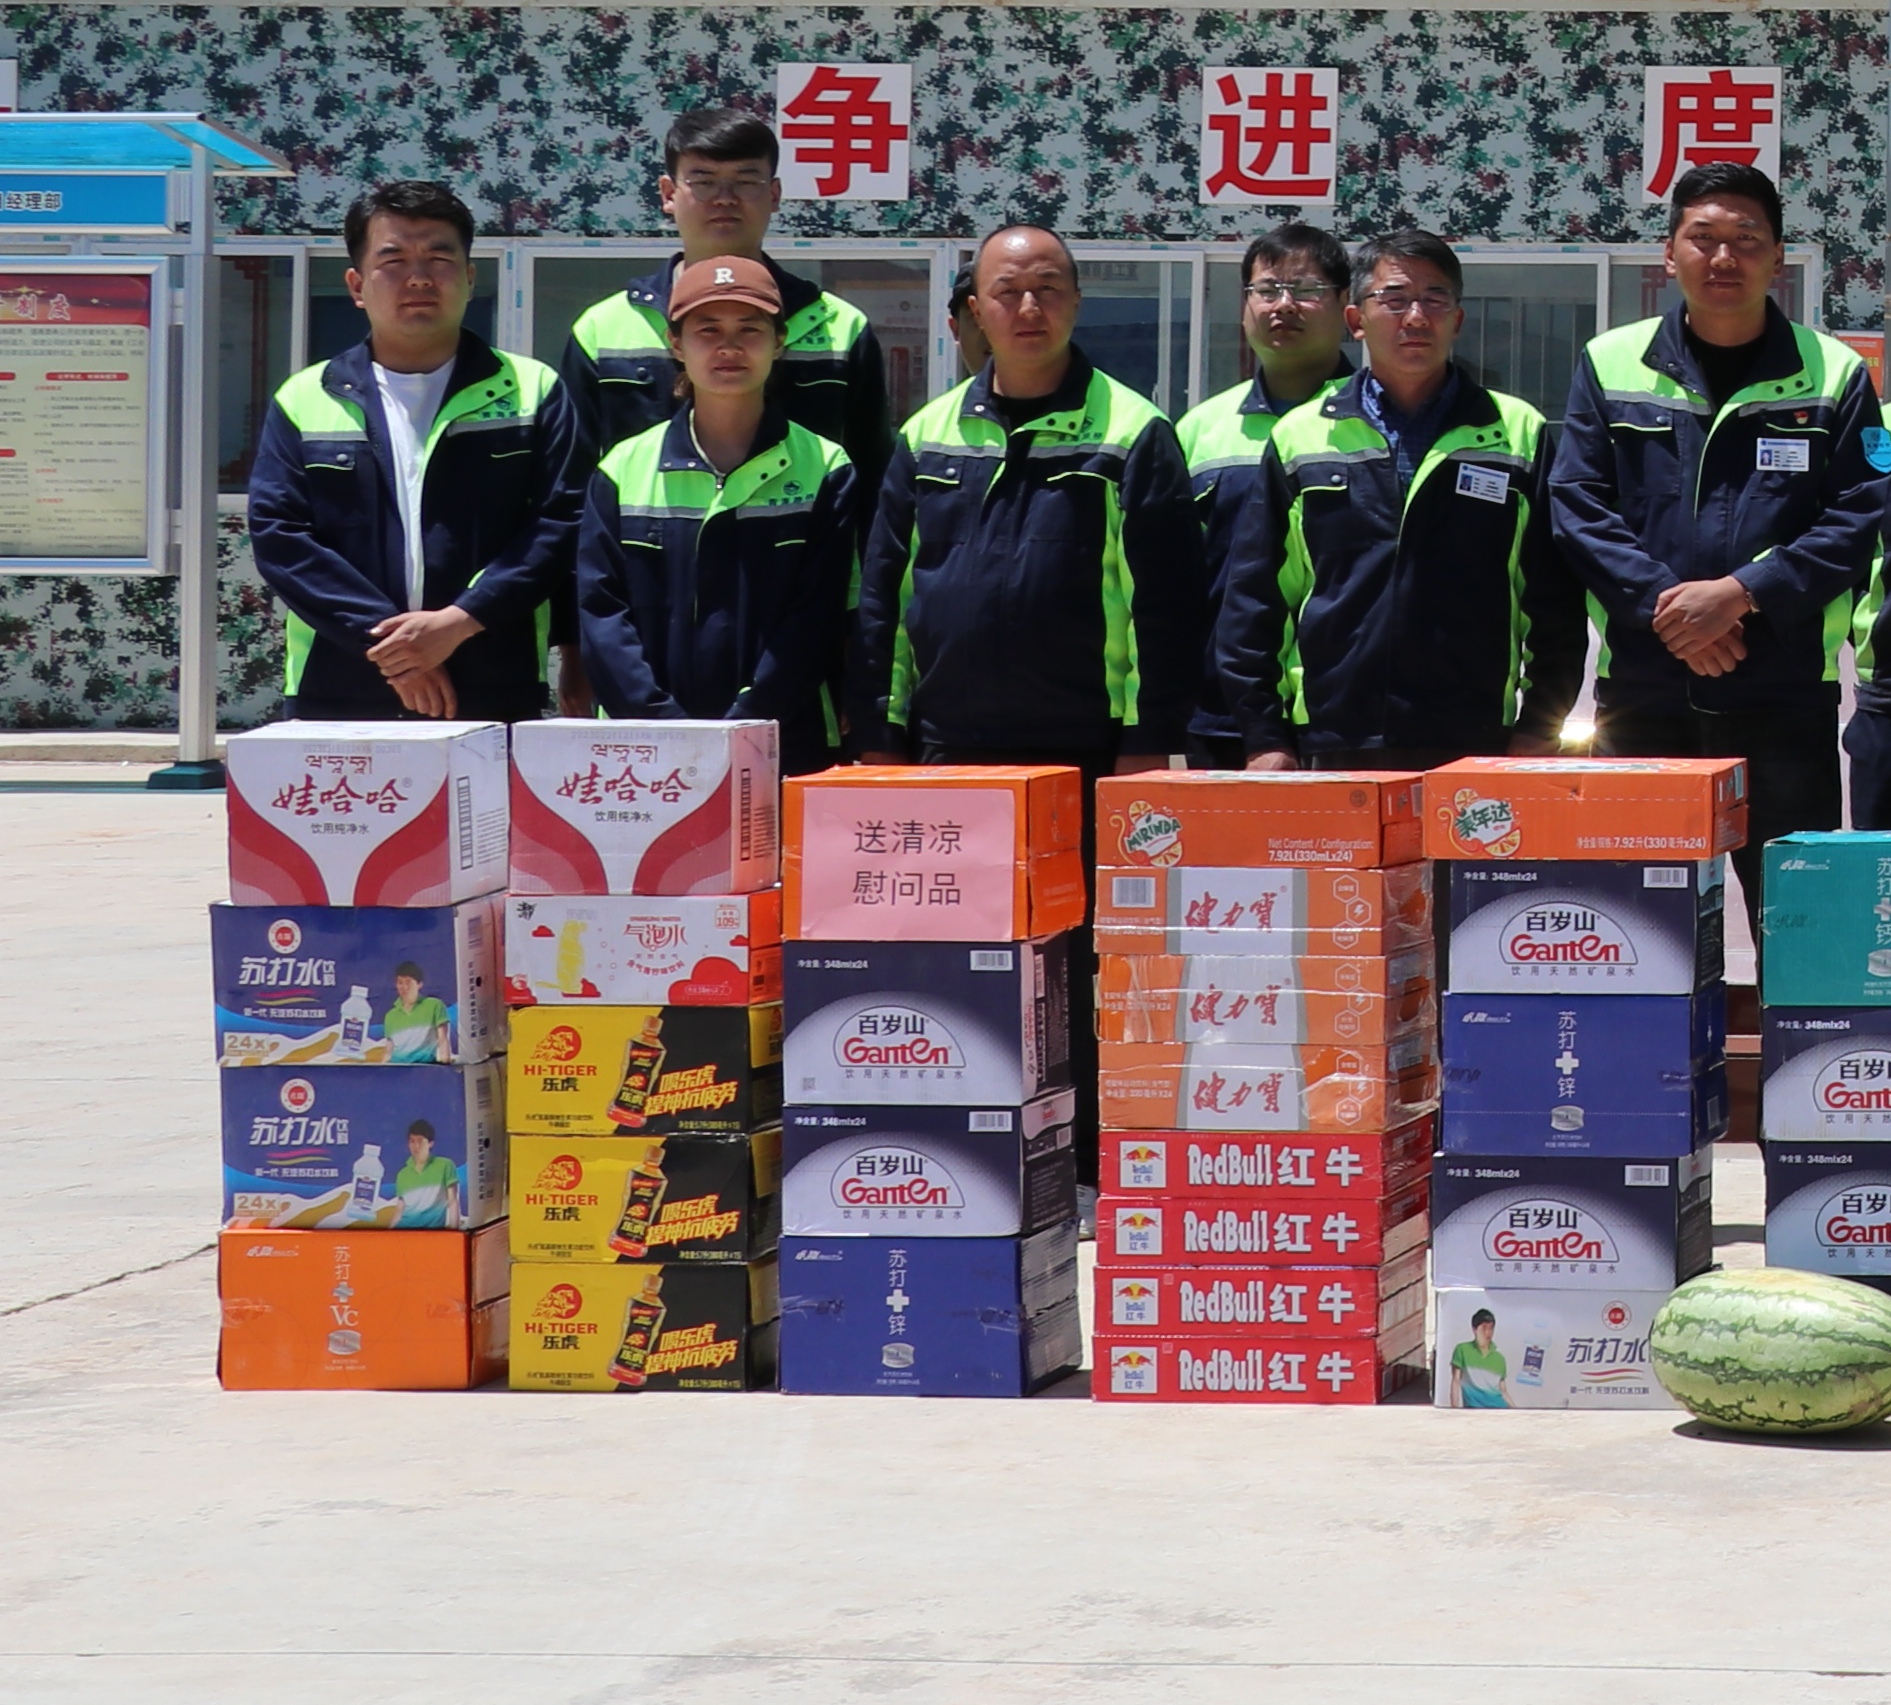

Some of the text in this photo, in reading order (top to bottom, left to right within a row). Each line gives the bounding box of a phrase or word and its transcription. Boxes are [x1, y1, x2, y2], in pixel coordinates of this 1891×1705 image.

[782, 66, 1776, 198] 争 进 度
[0, 191, 62, 212] 经理部
[715, 267, 733, 284] R
[273, 774, 408, 815] 娃哈哈
[556, 763, 692, 804] 娃哈哈
[1126, 814, 1182, 852] MIRINDA
[1455, 801, 1512, 839] 美年达
[855, 820, 963, 854] 送清凉
[852, 871, 960, 905] 慰问品
[1525, 911, 1597, 932] 百岁山
[623, 924, 689, 947] 气泡水
[1511, 934, 1619, 961] Ganten
[239, 957, 323, 987] 苏打水
[1511, 966, 1636, 977] 饮用天然矿泉水
[858, 1015, 926, 1036] 百岁山
[1557, 1012, 1577, 1050] 苏打
[845, 1038, 947, 1064] Ganten
[524, 1065, 597, 1076] HI-TIGER
[845, 1068, 965, 1079] 饮用天然矿泉水
[541, 1078, 579, 1091] 乐虎
[644, 1081, 738, 1117] 提神抗疲劳
[250, 1117, 335, 1145] 苏打水
[855, 1155, 924, 1175] 百岁山
[1187, 1144, 1364, 1187] RedBull 红牛
[525, 1194, 598, 1206] HI-TIGER
[842, 1178, 946, 1204] Ganten
[543, 1207, 581, 1221] 乐虎
[842, 1209, 963, 1220] 饮用天然矿泉水
[1509, 1208, 1578, 1229] 百岁山
[645, 1211, 740, 1246] 提神抗疲劳
[1184, 1211, 1361, 1254] RedBull 红牛
[1494, 1231, 1601, 1258] Ganten
[334, 1246, 350, 1280] 苏打
[888, 1249, 907, 1287] 苏打
[1495, 1263, 1617, 1273] 饮用天然矿泉水
[1179, 1281, 1357, 1324] RedBull 红牛
[524, 1322, 598, 1334] HI-TIGER
[542, 1335, 580, 1350] 乐虎
[1565, 1337, 1650, 1364] 苏打水
[644, 1339, 738, 1374] 提神抗疲劳
[1178, 1349, 1356, 1392] RedBull 红牛
